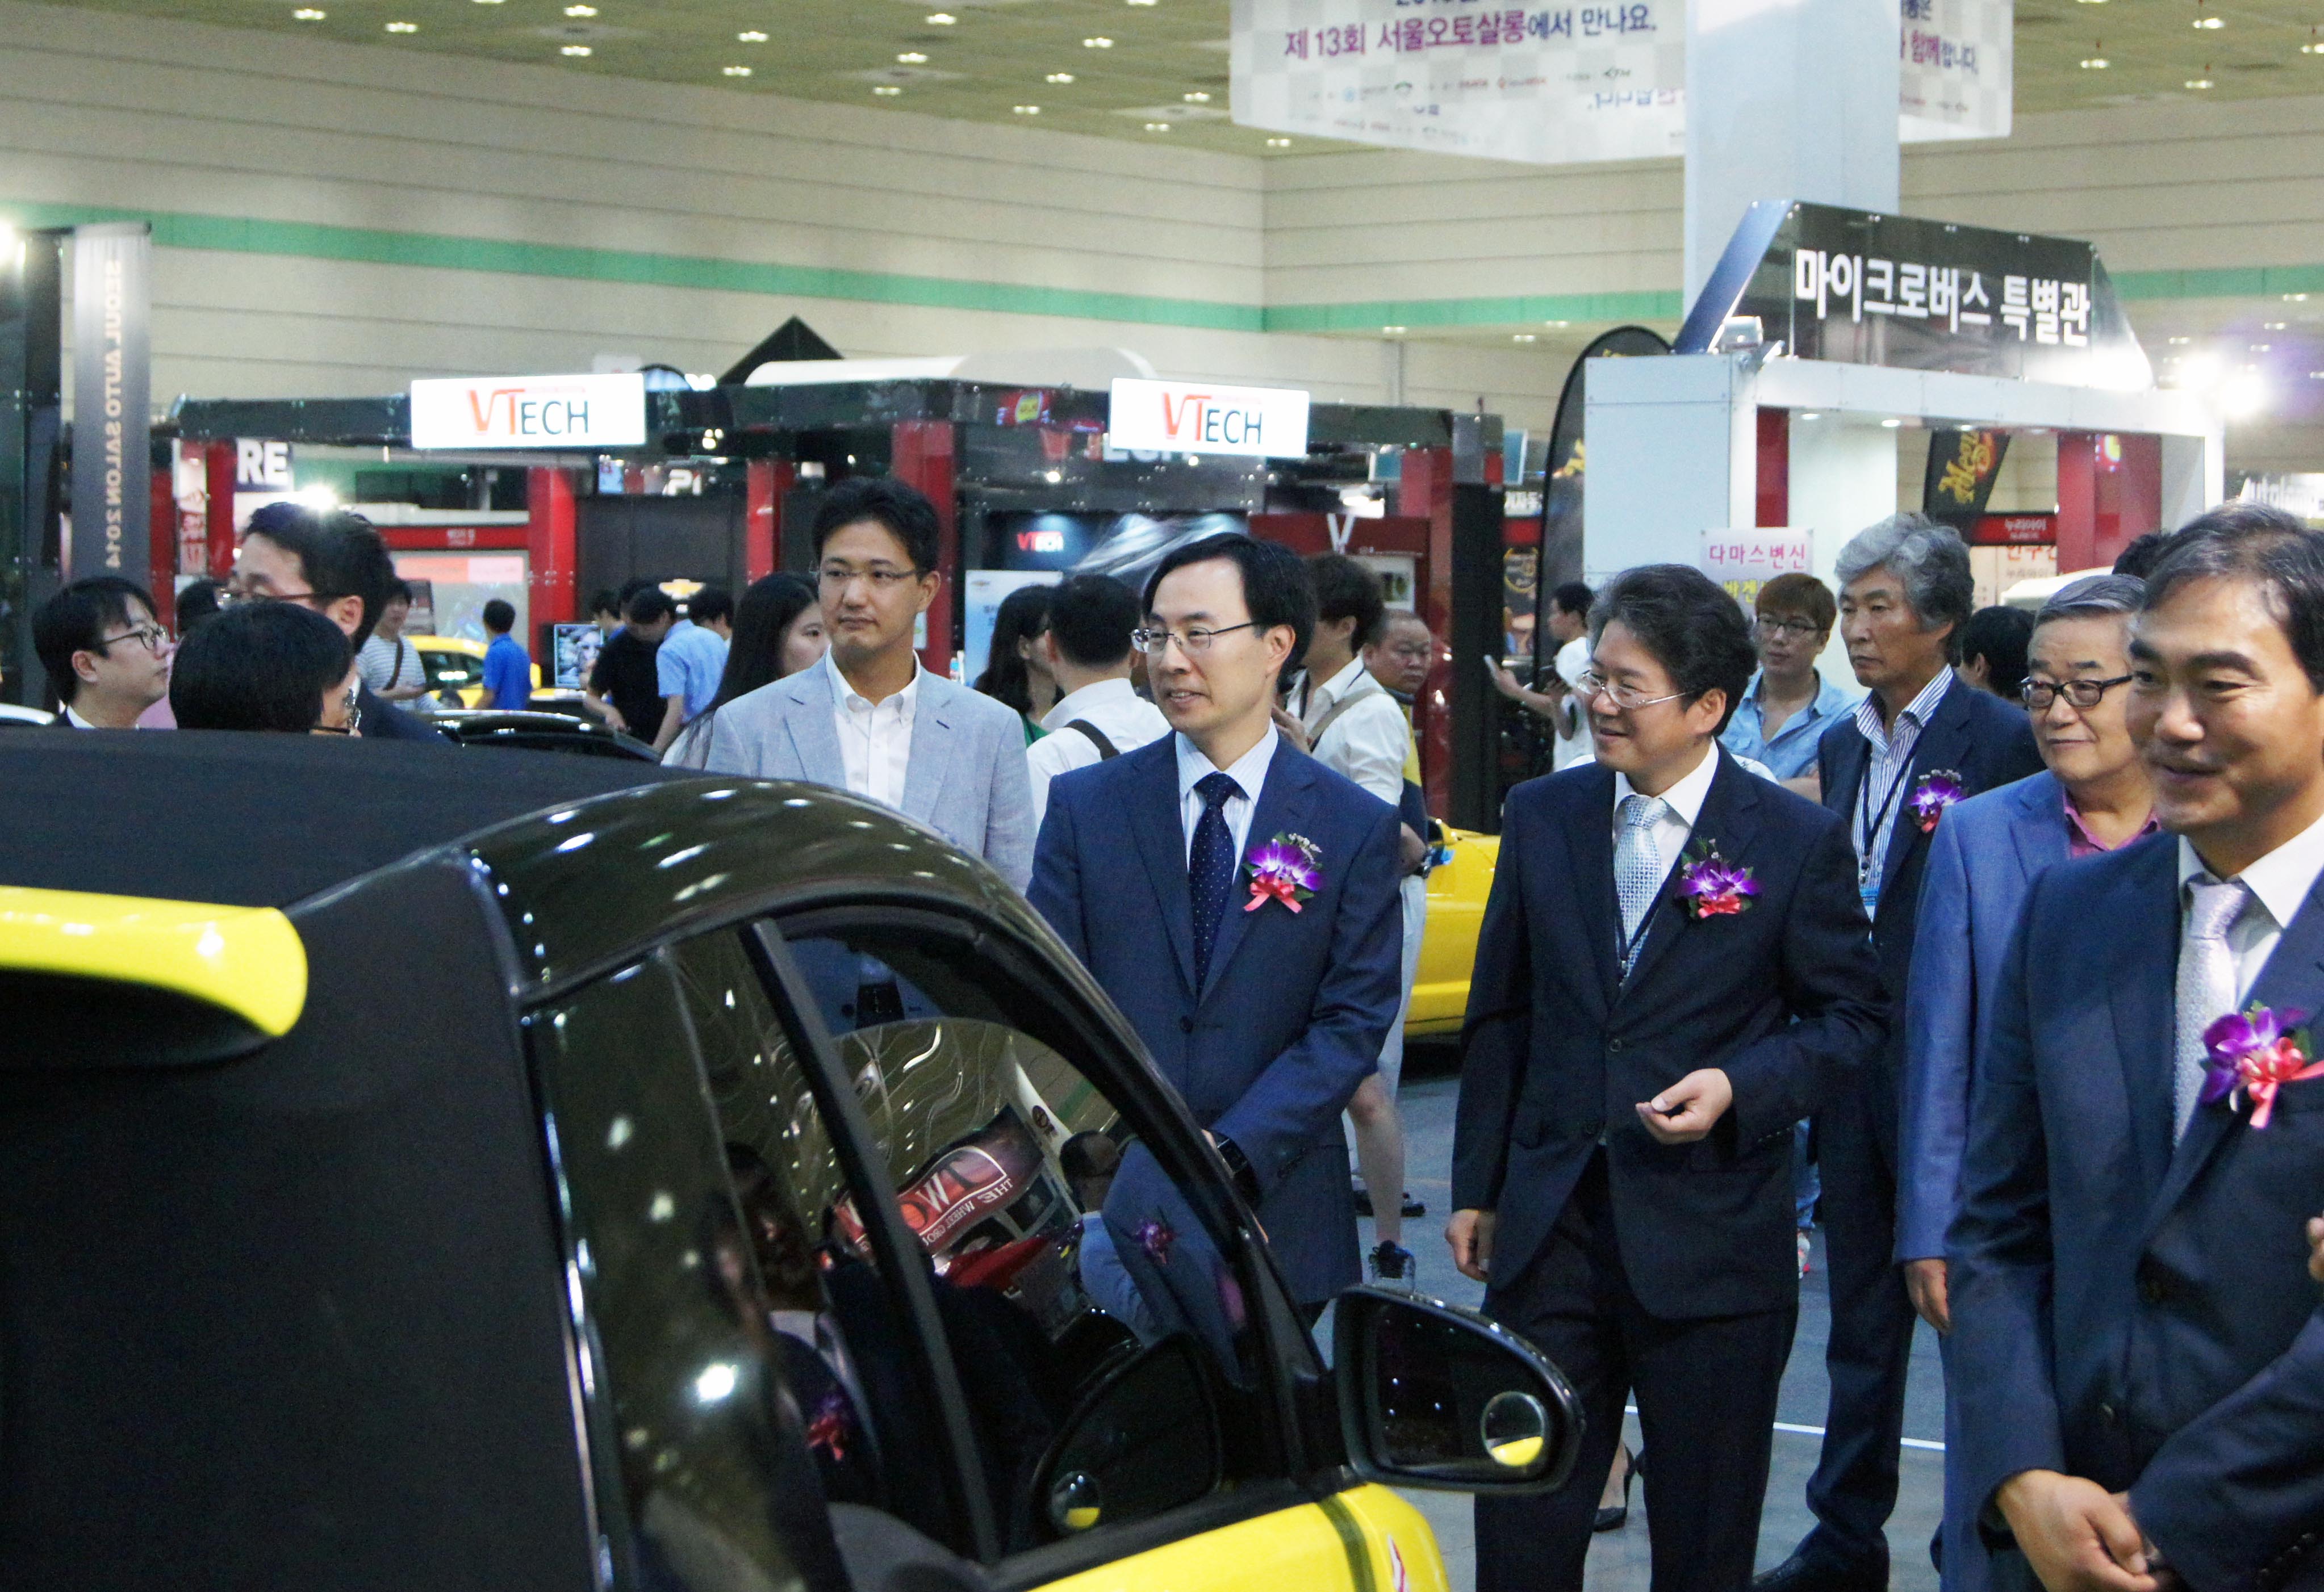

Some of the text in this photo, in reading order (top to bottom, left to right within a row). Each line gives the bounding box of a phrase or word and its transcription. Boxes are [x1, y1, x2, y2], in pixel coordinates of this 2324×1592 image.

[1378, 9, 1571, 52] 서울오토살롱에서
[1581, 4, 1657, 36] 만나요.
[1795, 249, 2090, 347] 마이크로버스 특별관
[467, 388, 589, 437] VTECH
[1163, 392, 1263, 445] VTECH
[1709, 543, 1805, 570] 다마스변신
